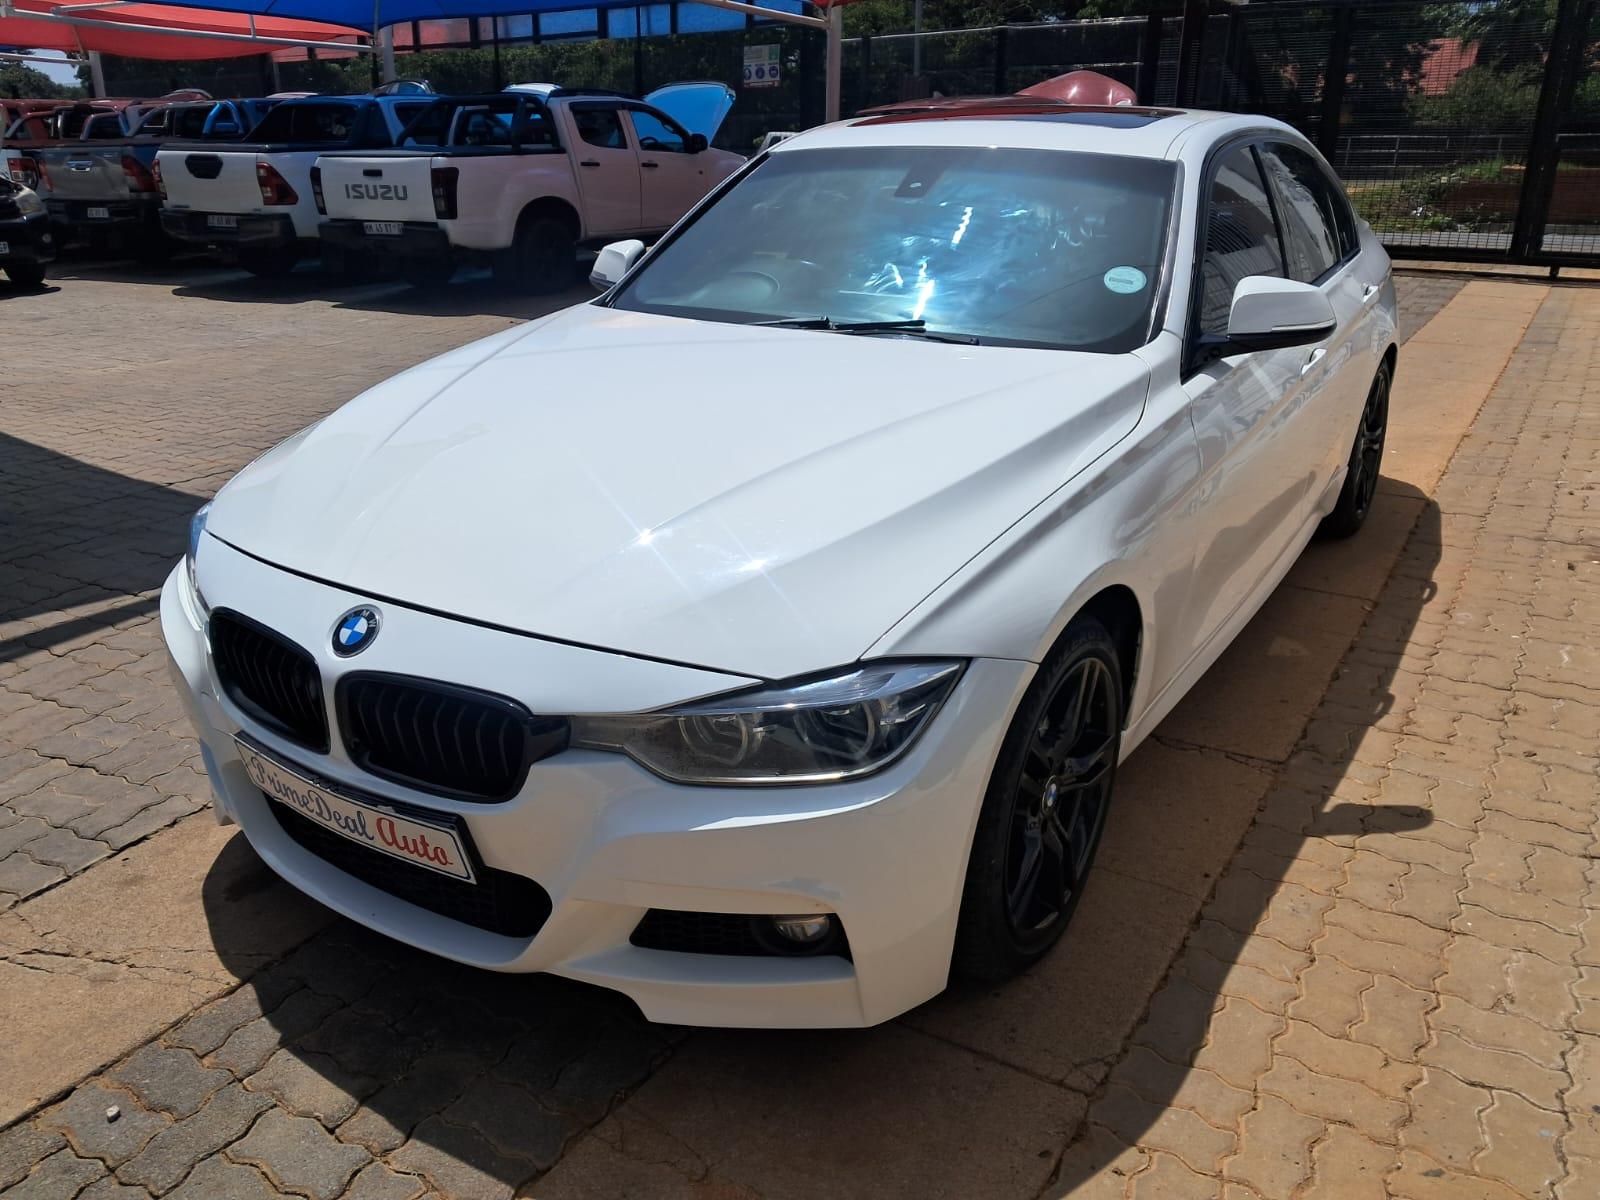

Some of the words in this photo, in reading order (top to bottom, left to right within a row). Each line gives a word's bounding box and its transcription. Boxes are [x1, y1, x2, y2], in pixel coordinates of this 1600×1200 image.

[344, 184, 408, 201] ISUZU
[250, 756, 374, 841] PrimeDeal
[376, 817, 454, 866] Auto
